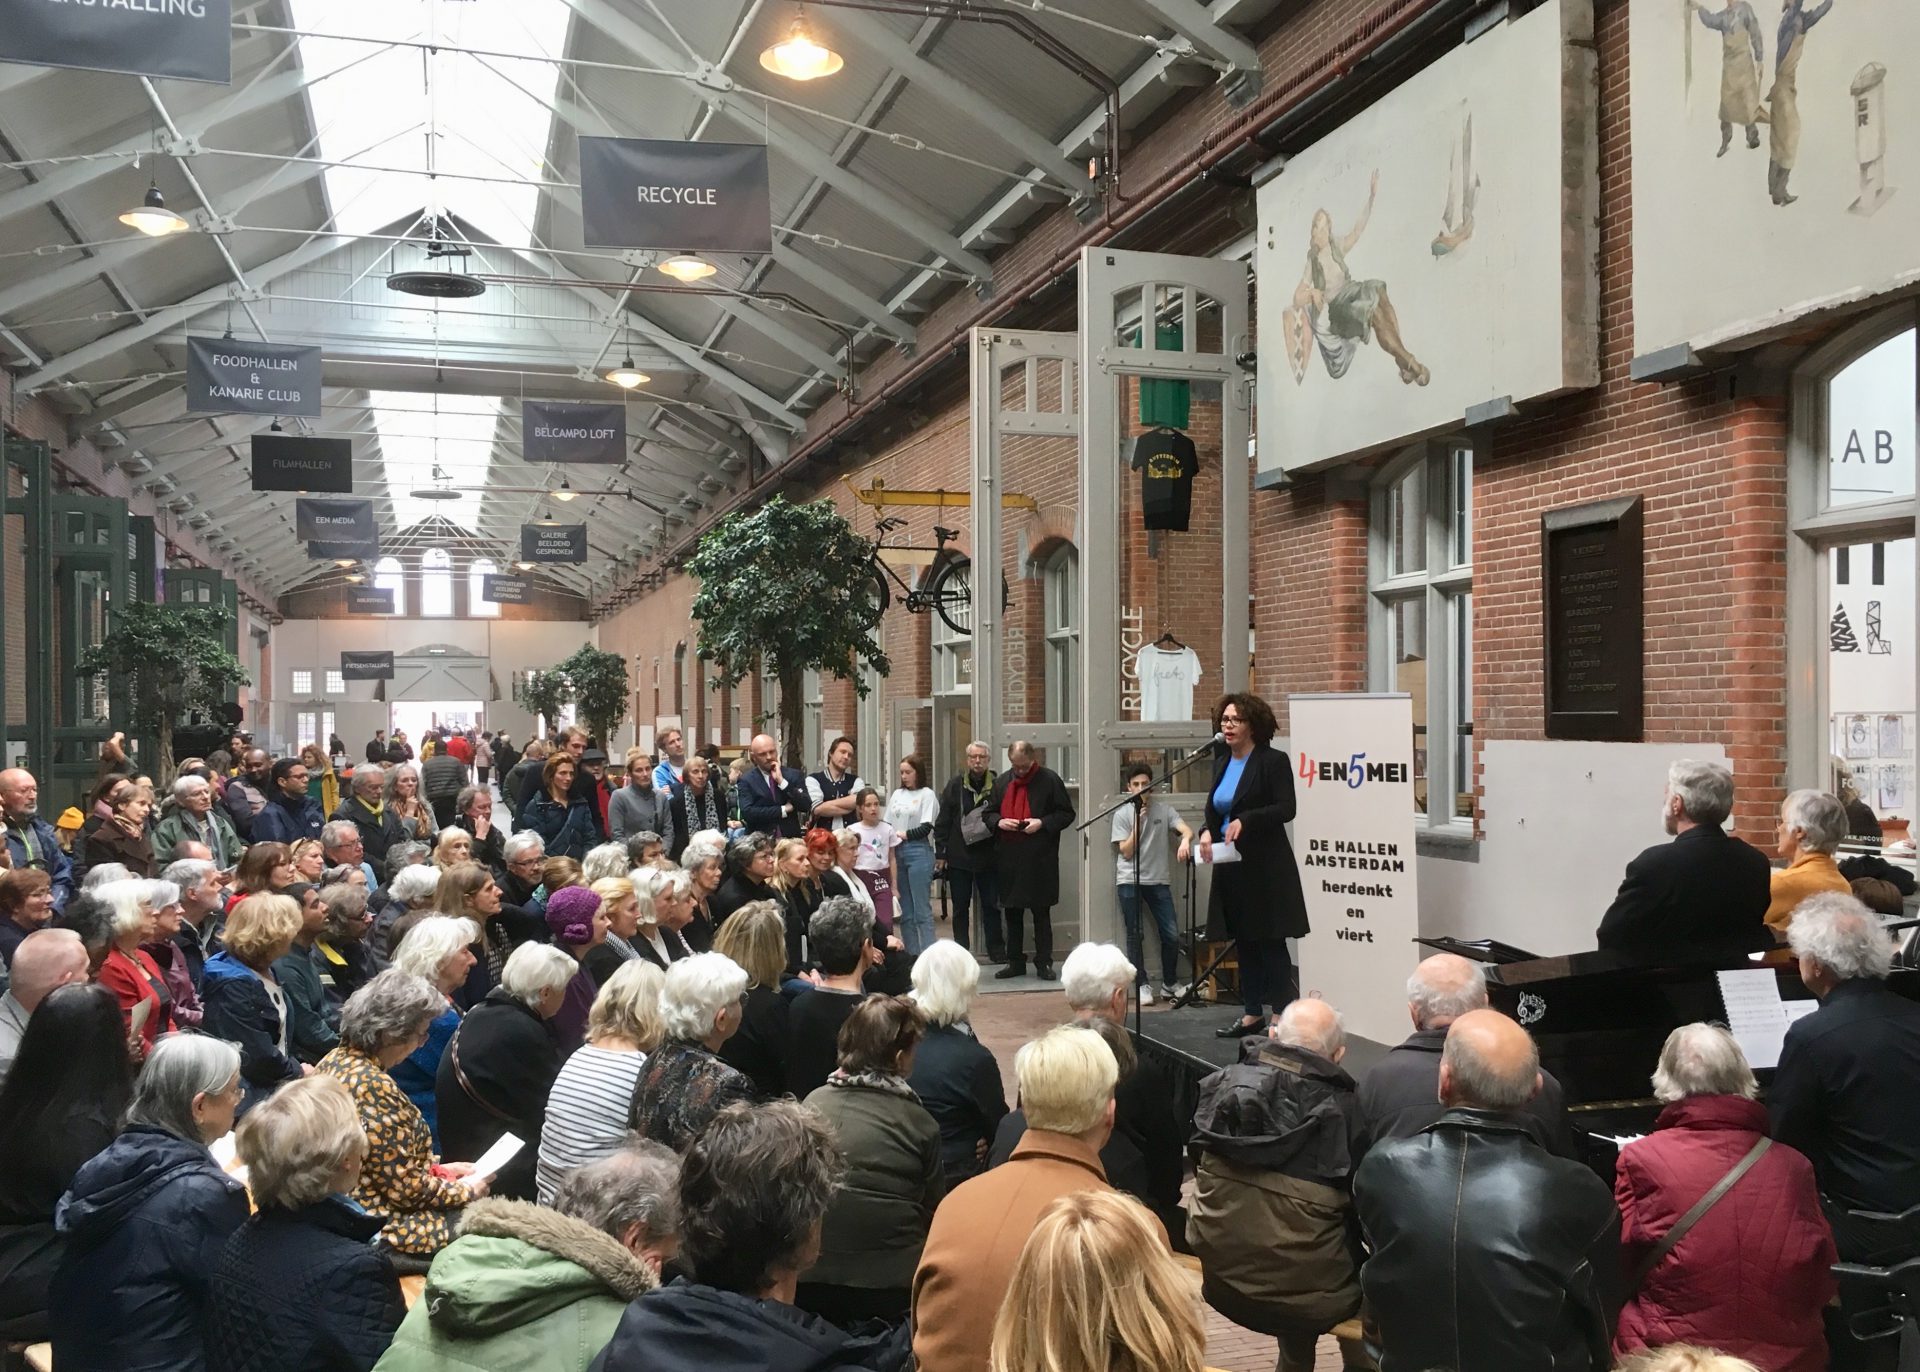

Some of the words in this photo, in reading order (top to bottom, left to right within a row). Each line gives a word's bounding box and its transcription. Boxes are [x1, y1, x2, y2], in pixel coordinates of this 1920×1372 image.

[637, 186, 717, 205] RECYCLE
[213, 354, 298, 371] FOODHALLEN
[250, 373, 260, 384] &
[209, 386, 264, 400] KANARIE
[267, 389, 301, 402] CLUB
[534, 427, 587, 439] BELCAMPO
[590, 429, 616, 439] LOFT
[1831, 428, 1894, 464] AB
[272, 459, 332, 470] FILMHALLEN
[332, 517, 355, 525] MEDIA
[1122, 605, 1143, 711] RECYCLE
[1310, 839, 1329, 851] DE
[1335, 841, 1398, 856] HALLEN
[1305, 854, 1404, 872] AMSTERDAM
[1322, 880, 1393, 898] herdenkt
[1346, 908, 1365, 918] en
[1336, 927, 1374, 943] viert
